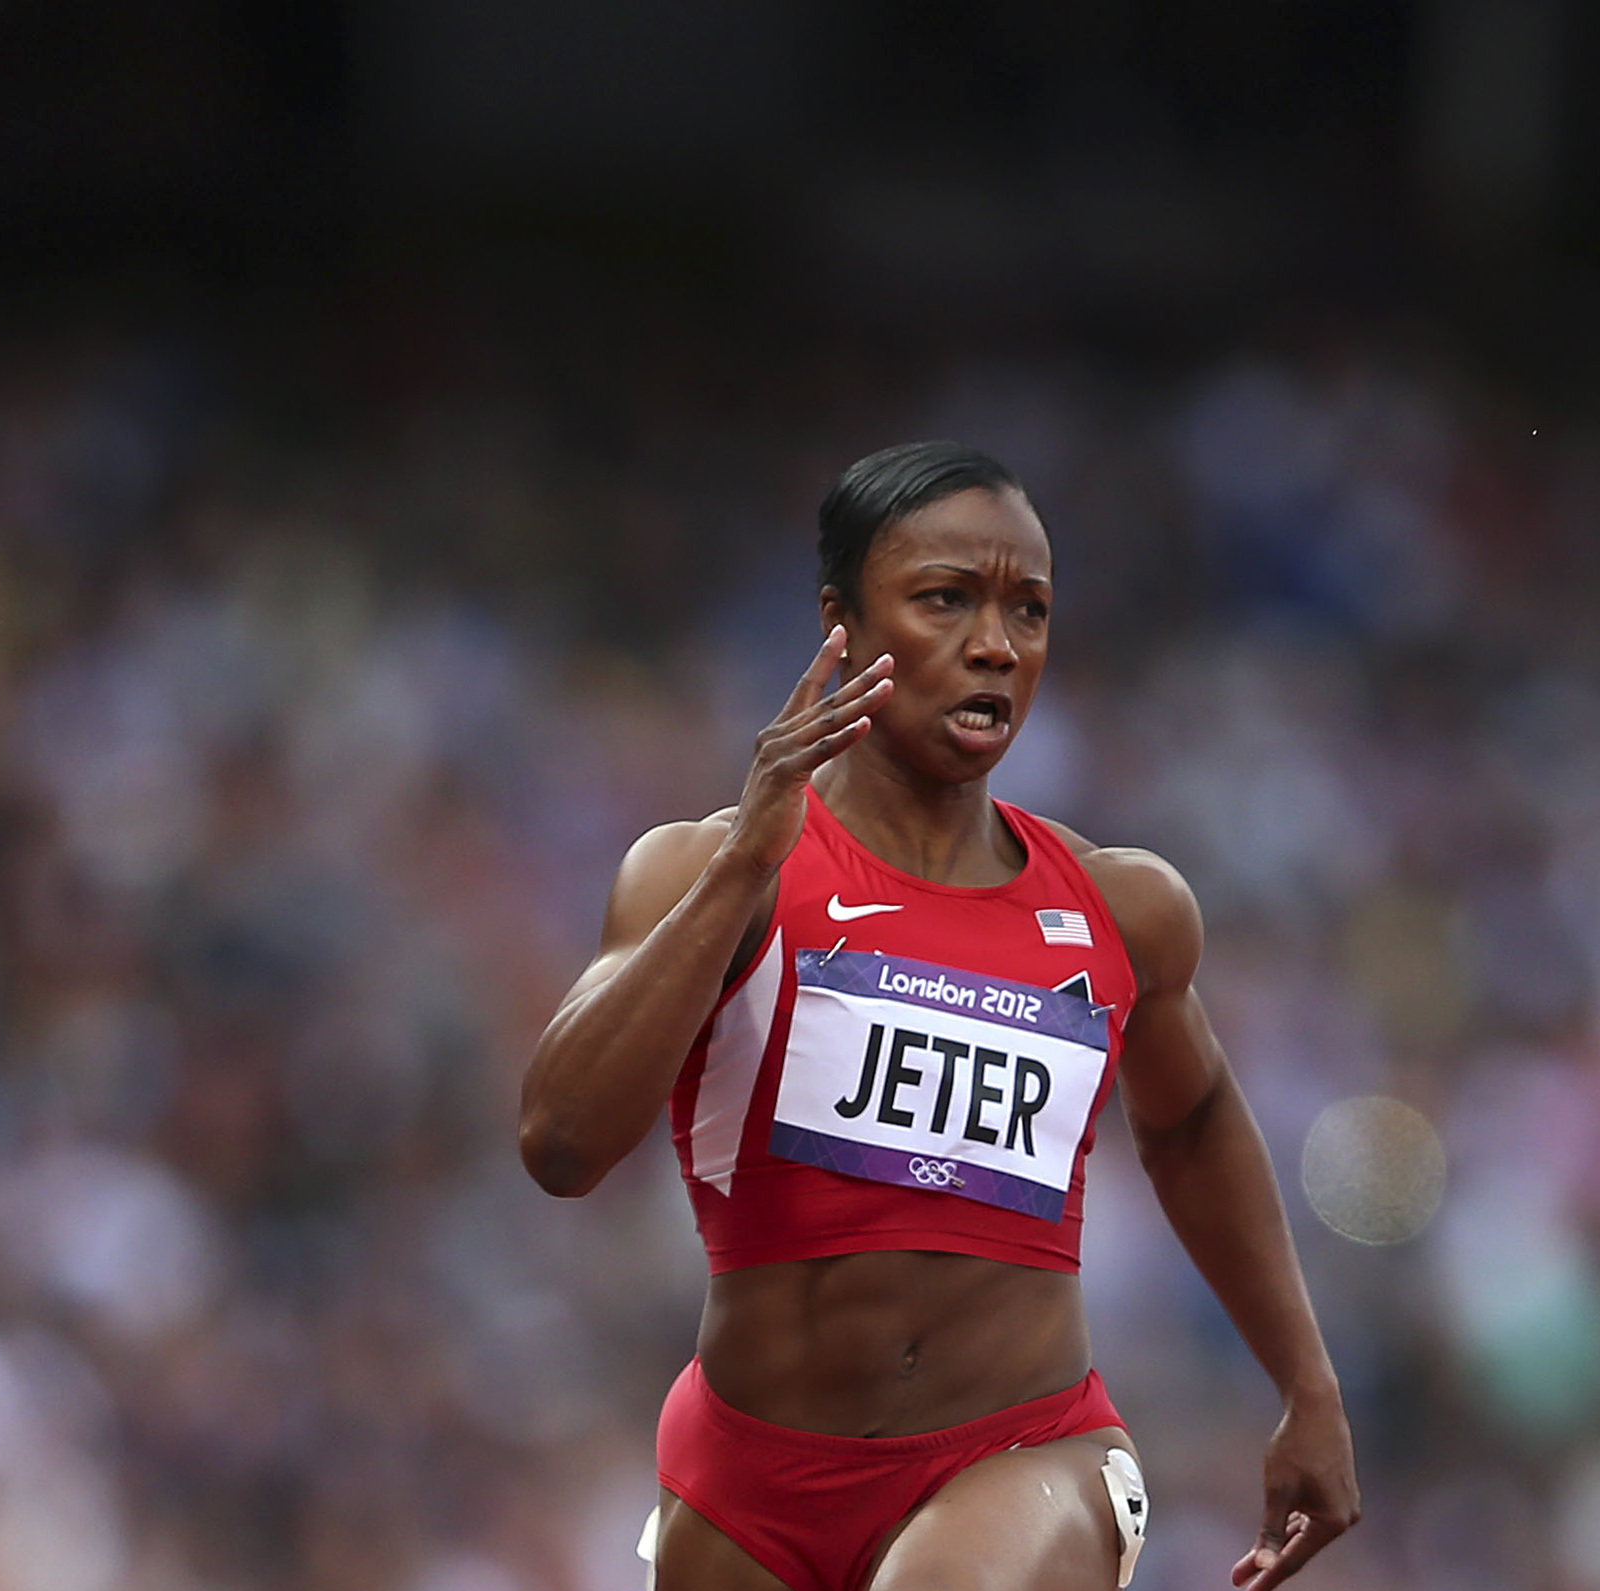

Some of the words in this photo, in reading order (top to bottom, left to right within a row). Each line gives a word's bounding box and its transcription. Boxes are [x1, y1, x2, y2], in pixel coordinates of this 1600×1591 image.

[878, 964, 976, 1009] London
[980, 984, 1043, 1023] 2012
[834, 1023, 1051, 1157] JETER
